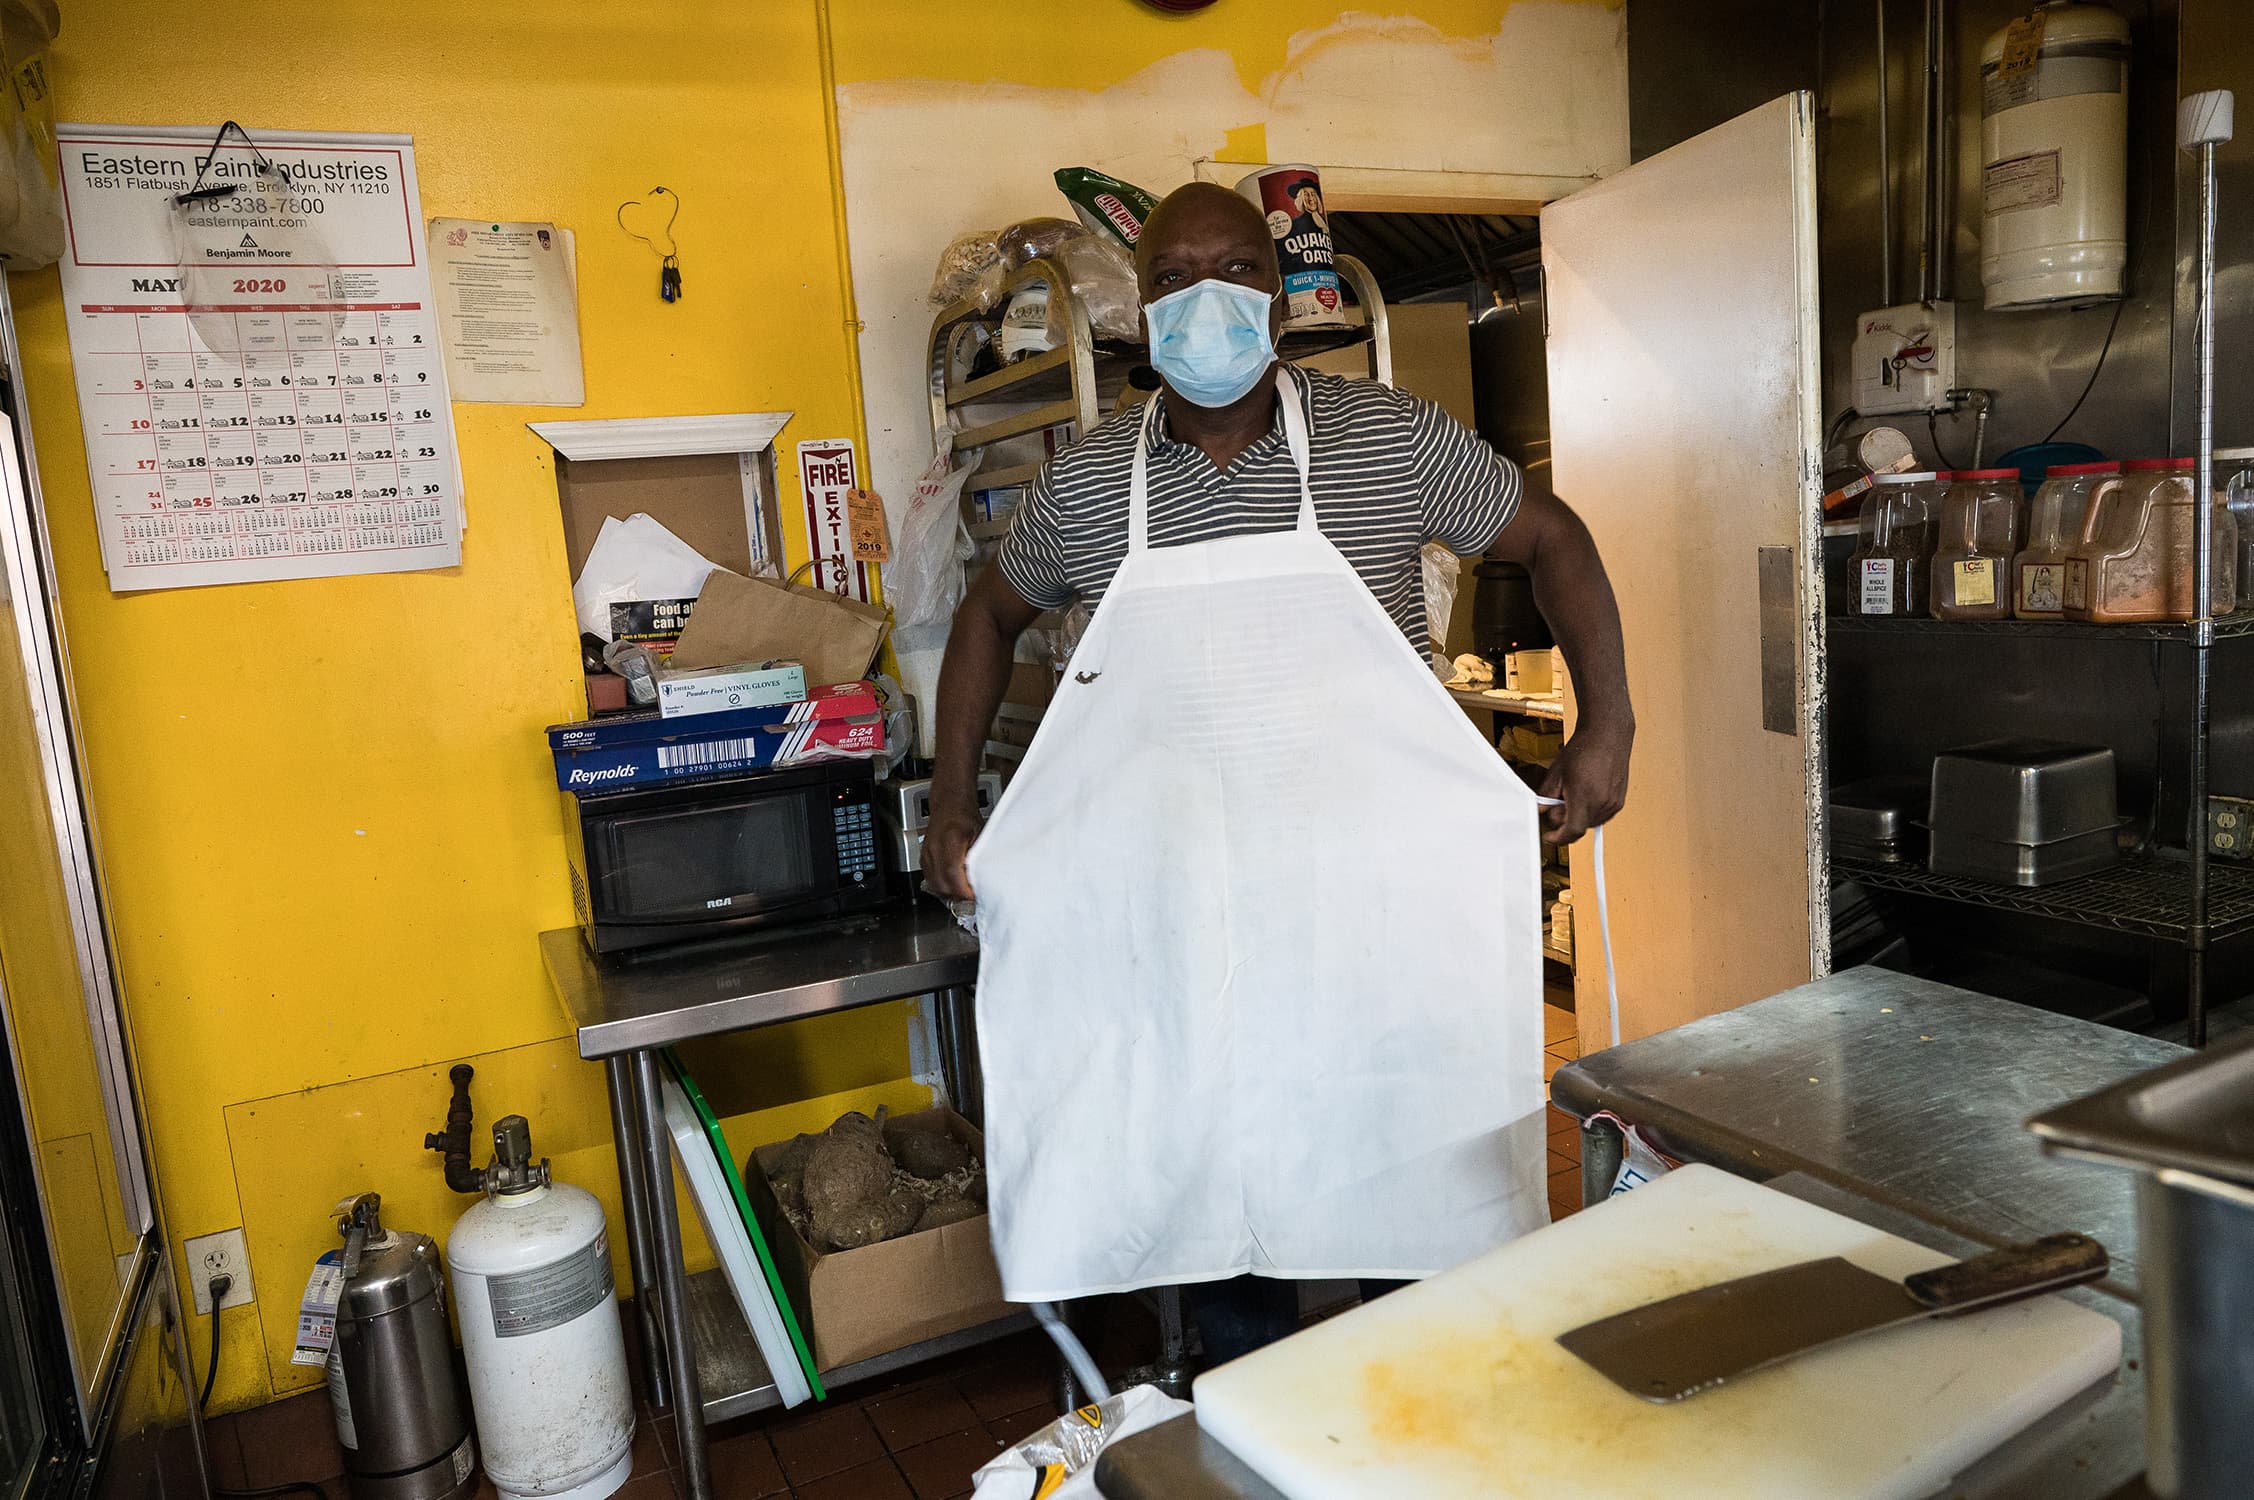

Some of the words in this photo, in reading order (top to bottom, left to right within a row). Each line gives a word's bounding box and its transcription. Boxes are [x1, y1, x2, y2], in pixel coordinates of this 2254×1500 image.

[82, 153, 185, 176] Eastern
[195, 156, 260, 178] Paint
[85, 177, 120, 189] 1851
[127, 178, 189, 191] Flatbush
[325, 183, 345, 194] NY
[351, 183, 390, 194] 11210
[188, 216, 308, 229] easternpaint.com
[1284, 232, 1334, 254] QUAKE
[206, 249, 255, 259] Benjamin
[257, 249, 292, 258] Moore
[1303, 250, 1334, 265] OATS
[132, 279, 179, 292] MAY
[233, 279, 286, 293] 2020
[1292, 275, 1313, 286] QUICK
[368, 336, 377, 345] 1
[412, 335, 422, 344] 2
[233, 378, 243, 388] 5
[280, 375, 291, 386] 6
[327, 375, 337, 386] 7
[373, 373, 383, 383] 8
[417, 372, 427, 383] 9
[133, 380, 144, 390] 3
[184, 378, 194, 389] 4
[324, 414, 343, 424] 14
[370, 412, 388, 422] 15
[414, 409, 432, 419] 16
[130, 419, 150, 430] 10
[181, 418, 200, 428] 11
[230, 417, 249, 427] 12
[277, 415, 297, 426] 13
[329, 452, 348, 462] 21
[374, 450, 393, 459] 22
[418, 447, 436, 457] 23
[136, 459, 156, 470] 17
[187, 457, 206, 468] 18
[235, 456, 254, 467] 19
[282, 454, 302, 464] 20
[808, 463, 850, 487] FIRE
[334, 489, 353, 499] 28
[379, 487, 398, 497] 29
[423, 484, 440, 495] 30
[192, 497, 213, 508] 25
[241, 494, 260, 504] 26
[288, 492, 307, 503] 27
[150, 502, 163, 510] 31
[857, 542, 882, 551] 2019
[653, 603, 681, 616] Food
[652, 618, 675, 629] can
[686, 689, 709, 697] Powder
[728, 684, 751, 692] VINYL
[752, 680, 781, 689] GLOVES
[562, 731, 583, 740] 500
[848, 727, 873, 737] 624
[674, 767, 684, 775] 00
[689, 764, 713, 773] 27901
[718, 761, 742, 770] 00624
[747, 759, 752, 767] 2
[569, 764, 635, 785] Reynolds
[706, 897, 732, 909] RCA
